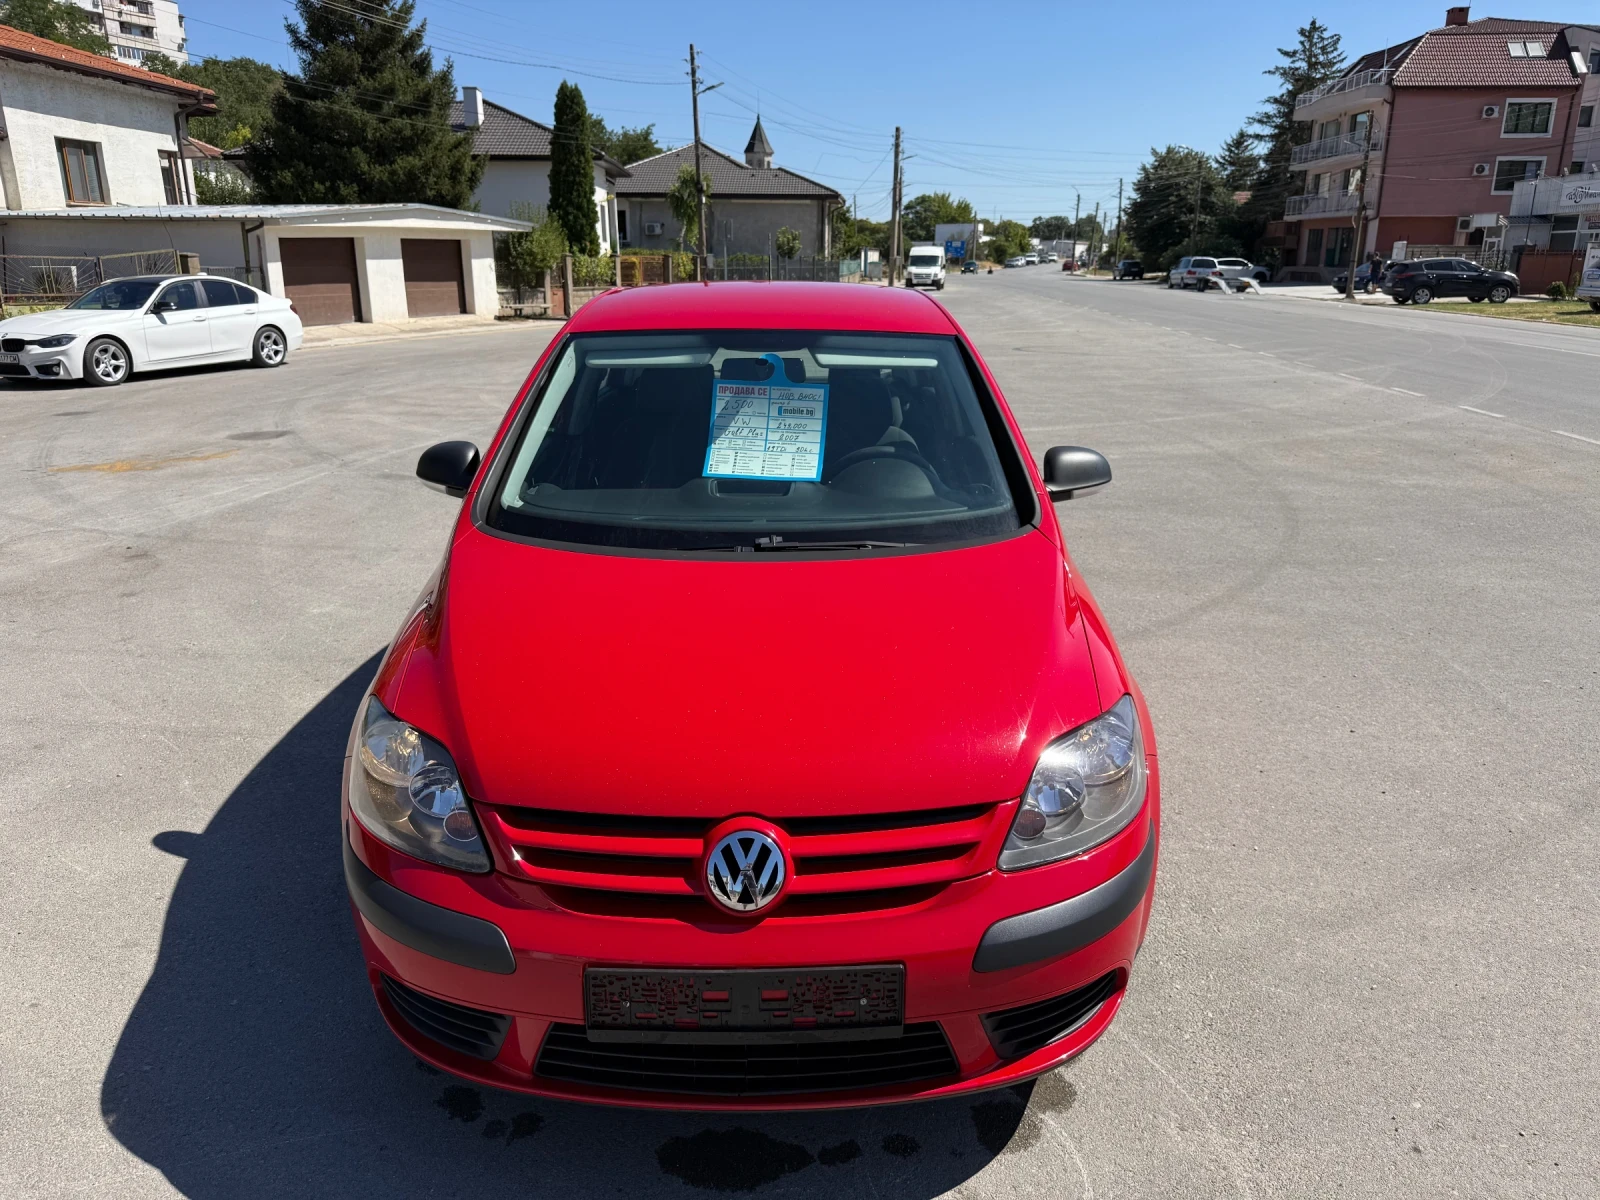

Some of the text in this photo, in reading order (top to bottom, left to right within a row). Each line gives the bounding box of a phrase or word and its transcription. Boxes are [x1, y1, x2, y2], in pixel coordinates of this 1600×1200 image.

[718, 385, 768, 396] ПРОДАВА СЕ
[782, 407, 814, 416] mobile.bg
[724, 427, 744, 437] Golf
[747, 428, 764, 437] Plus
[778, 433, 800, 441] 2007
[711, 834, 781, 907] VW
